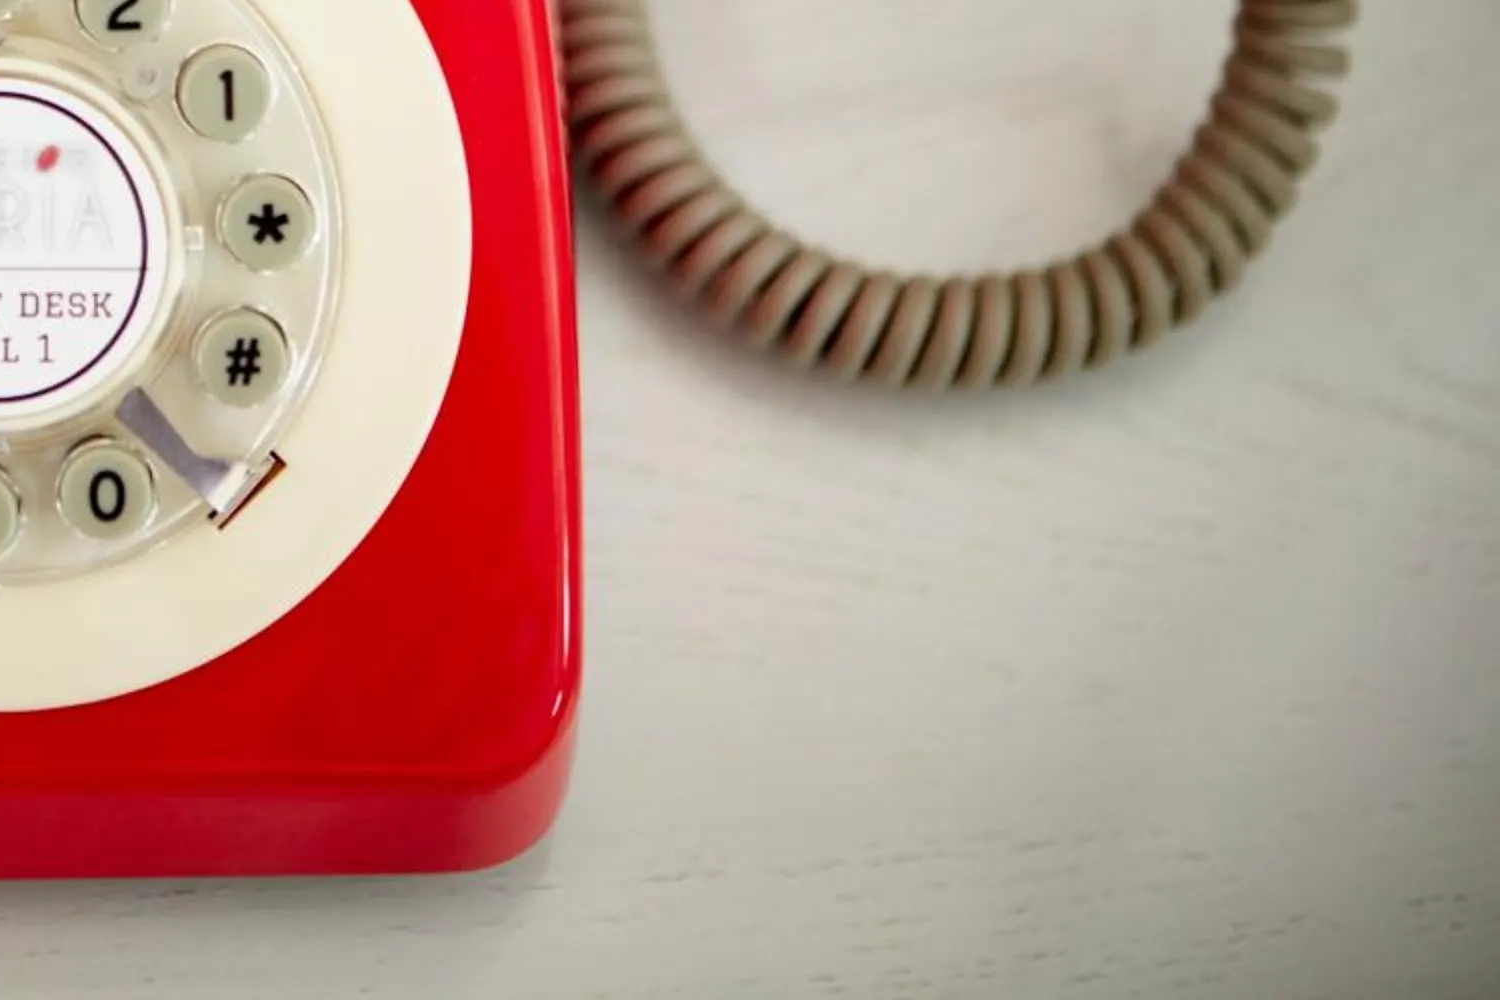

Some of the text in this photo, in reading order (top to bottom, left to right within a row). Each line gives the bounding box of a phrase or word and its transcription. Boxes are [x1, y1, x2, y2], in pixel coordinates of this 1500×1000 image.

[218, 69, 235, 121] 1
[19, 290, 114, 319] DESK
[37, 333, 55, 364] 1
[225, 337, 261, 387] #
[88, 469, 127, 523] 0
